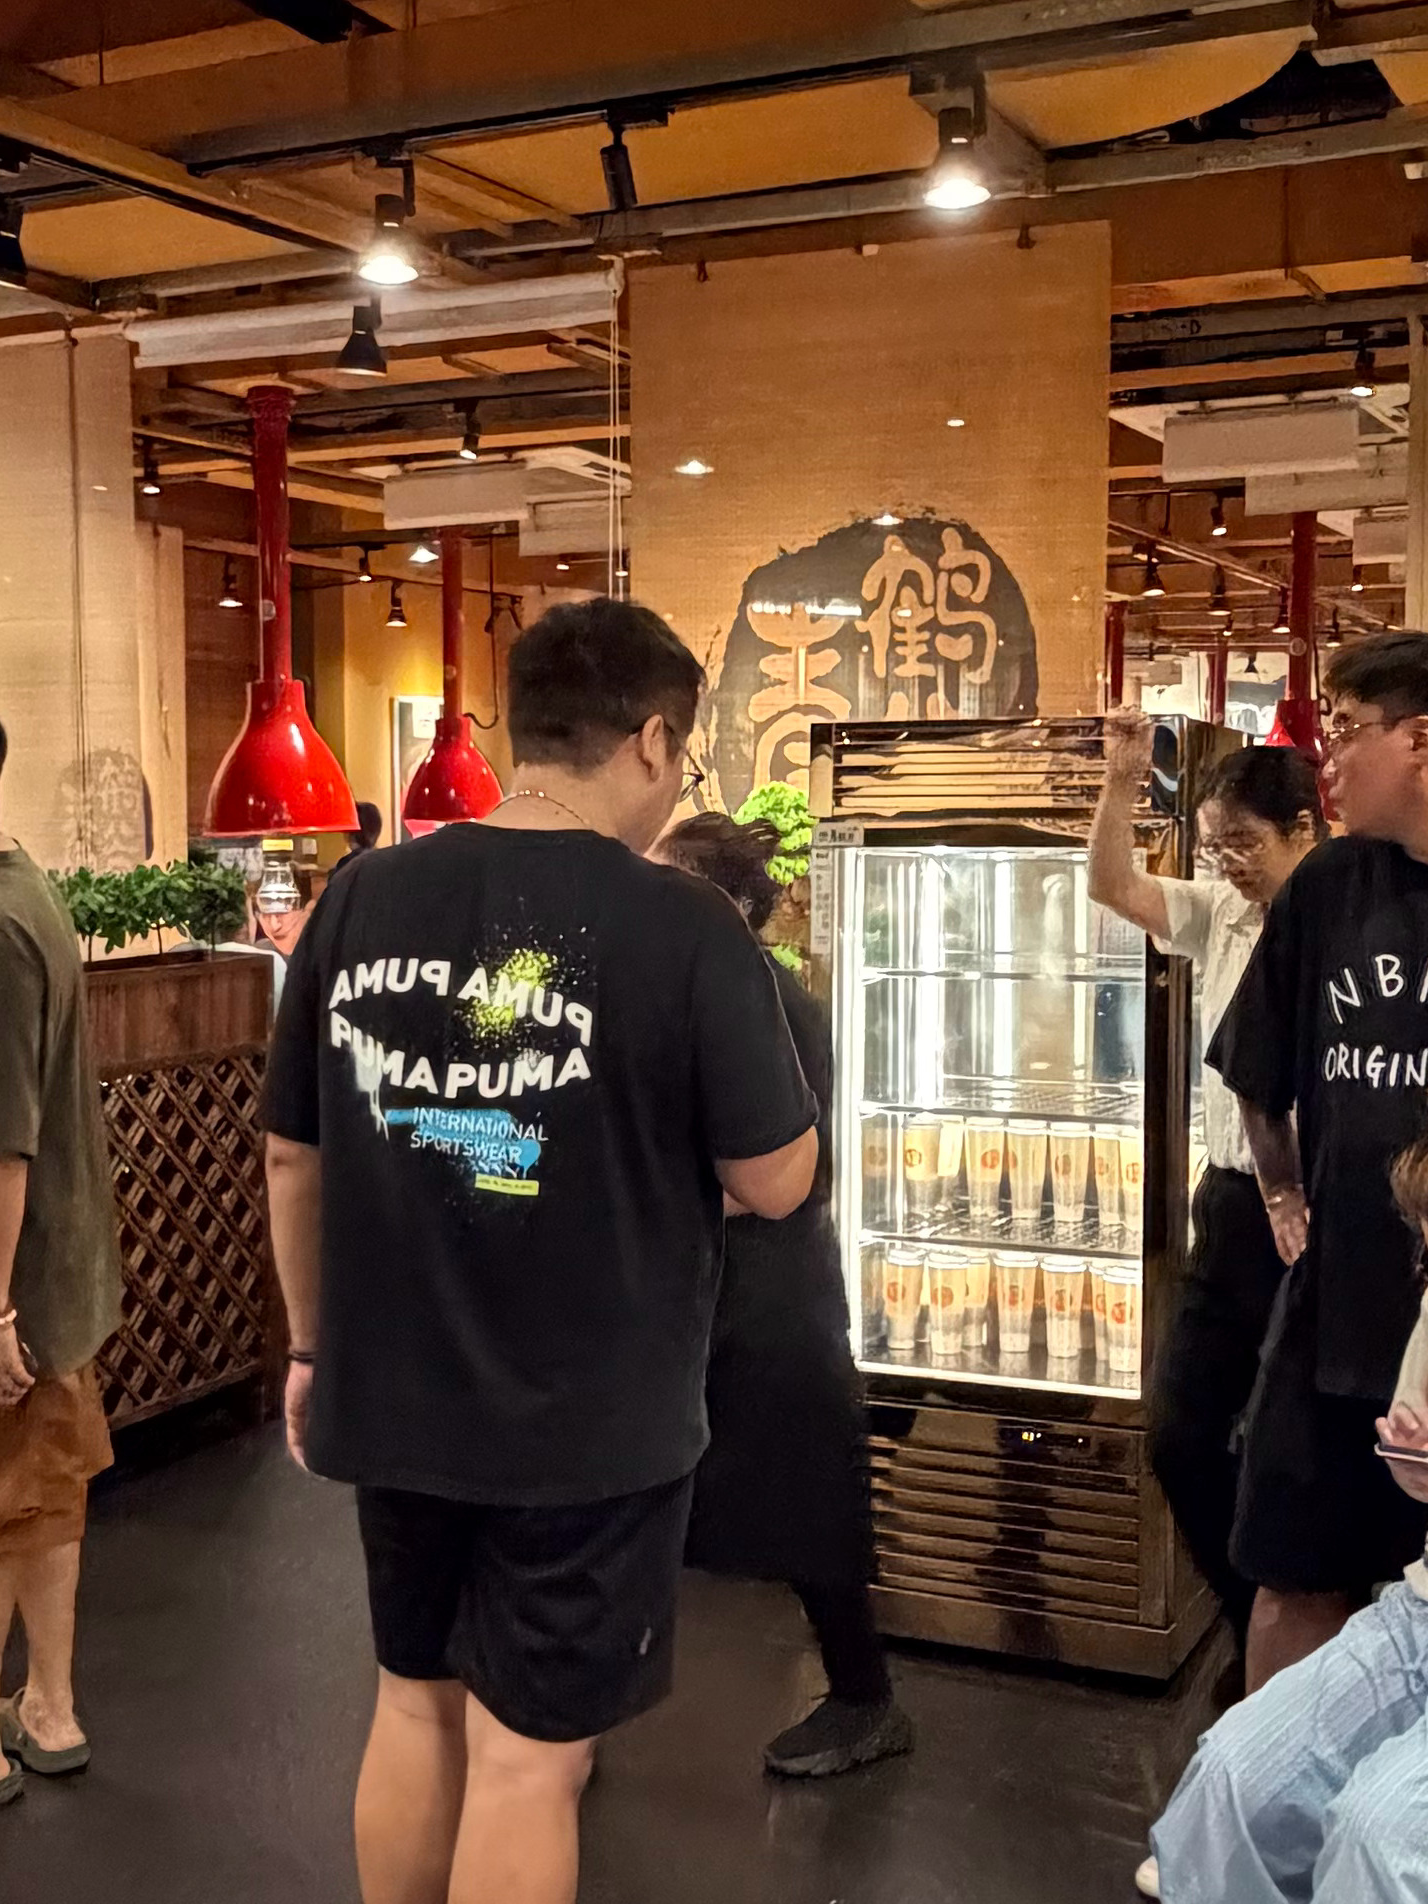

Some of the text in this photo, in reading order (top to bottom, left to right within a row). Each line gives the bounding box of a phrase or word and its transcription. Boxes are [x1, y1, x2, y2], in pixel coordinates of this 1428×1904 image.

[330, 1011, 592, 1099] PUMA PUMA
[412, 1106, 549, 1142] INTERNATIONAL
[410, 1130, 522, 1164] SPORTSWEAR
